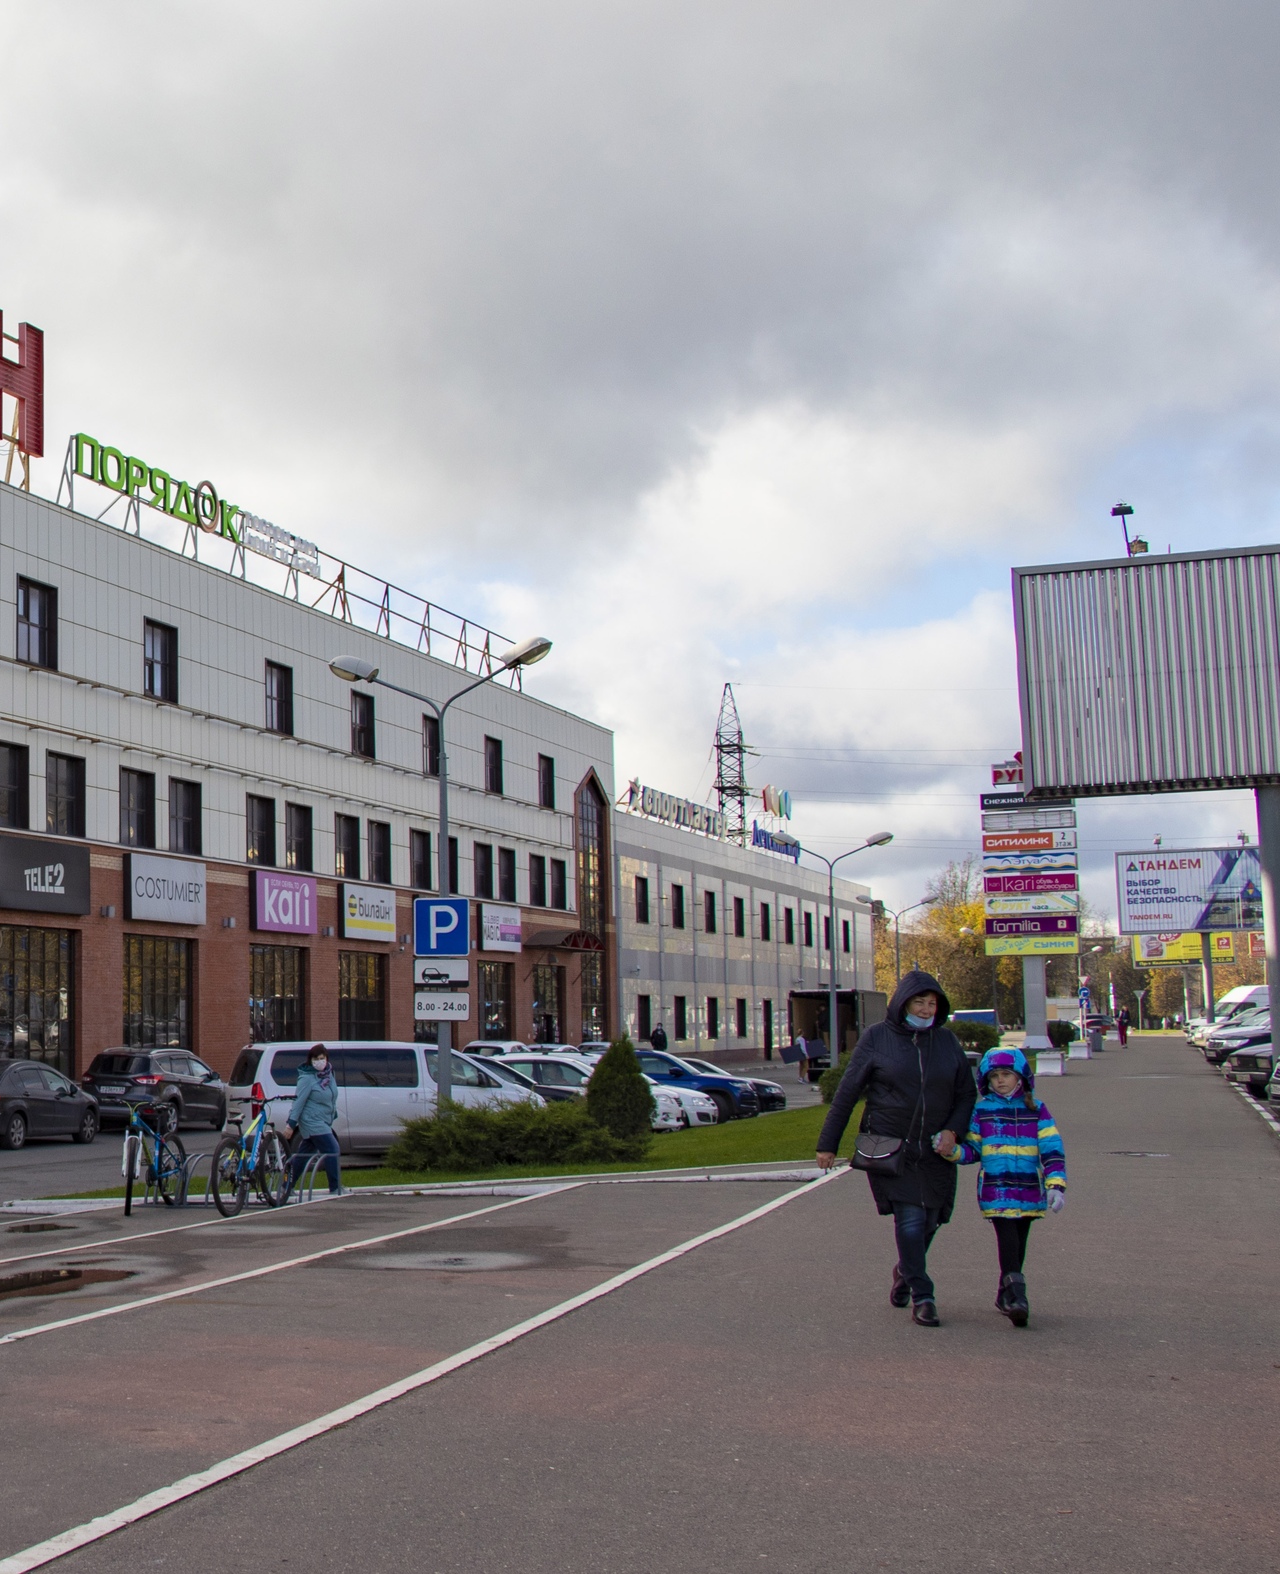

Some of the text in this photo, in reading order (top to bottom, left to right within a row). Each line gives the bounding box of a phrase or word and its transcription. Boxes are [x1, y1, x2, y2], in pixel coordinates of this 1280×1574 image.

[75, 432, 240, 543] ПОРЯДОК
[986, 837, 1049, 847] СИТИЛИНК
[1061, 832, 1066, 840] 2
[1139, 858, 1201, 871] ТАНДЕМ
[24, 862, 65, 894] TELE2
[1005, 876, 1035, 891] kari
[1126, 879, 1161, 887] ВЫБОР
[135, 876, 200, 903] COSTUMIER
[1127, 887, 1176, 896] КАЧЕСТВО
[264, 878, 309, 926] kari
[1127, 895, 1203, 904] БЕЗОПАСНОСТЬ
[429, 905, 459, 949] P
[993, 920, 1041, 932] familia
[1034, 941, 1074, 949] СУМКА
[417, 1002, 435, 1011] 8.00
[443, 1002, 467, 1011] 24.00
